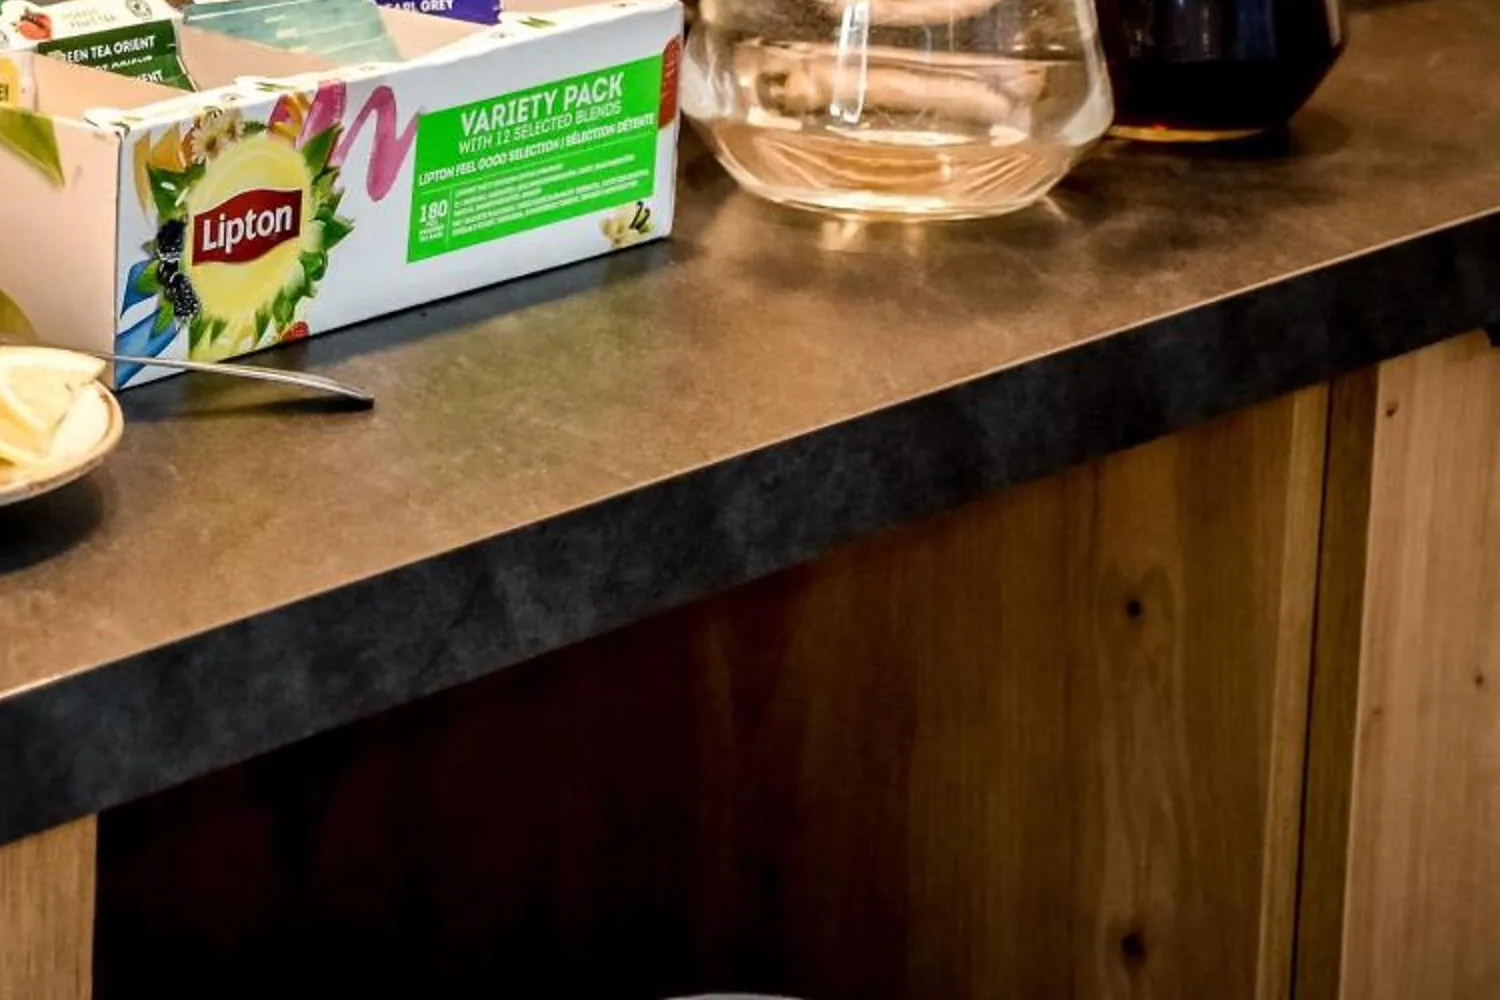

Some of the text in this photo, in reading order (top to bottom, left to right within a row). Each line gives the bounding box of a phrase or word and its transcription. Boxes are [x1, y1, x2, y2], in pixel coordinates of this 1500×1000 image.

[90, 44, 112, 59] TEA
[113, 35, 156, 55] ORIENT
[459, 100, 623, 154] WITH 12 SELECTED BLENDS
[460, 87, 559, 137] VARIETY
[563, 71, 625, 111] PACK
[419, 166, 454, 187] LIPTON
[455, 160, 477, 177] FEEL
[478, 152, 508, 171] GOOD
[202, 204, 293, 254] Lipton
